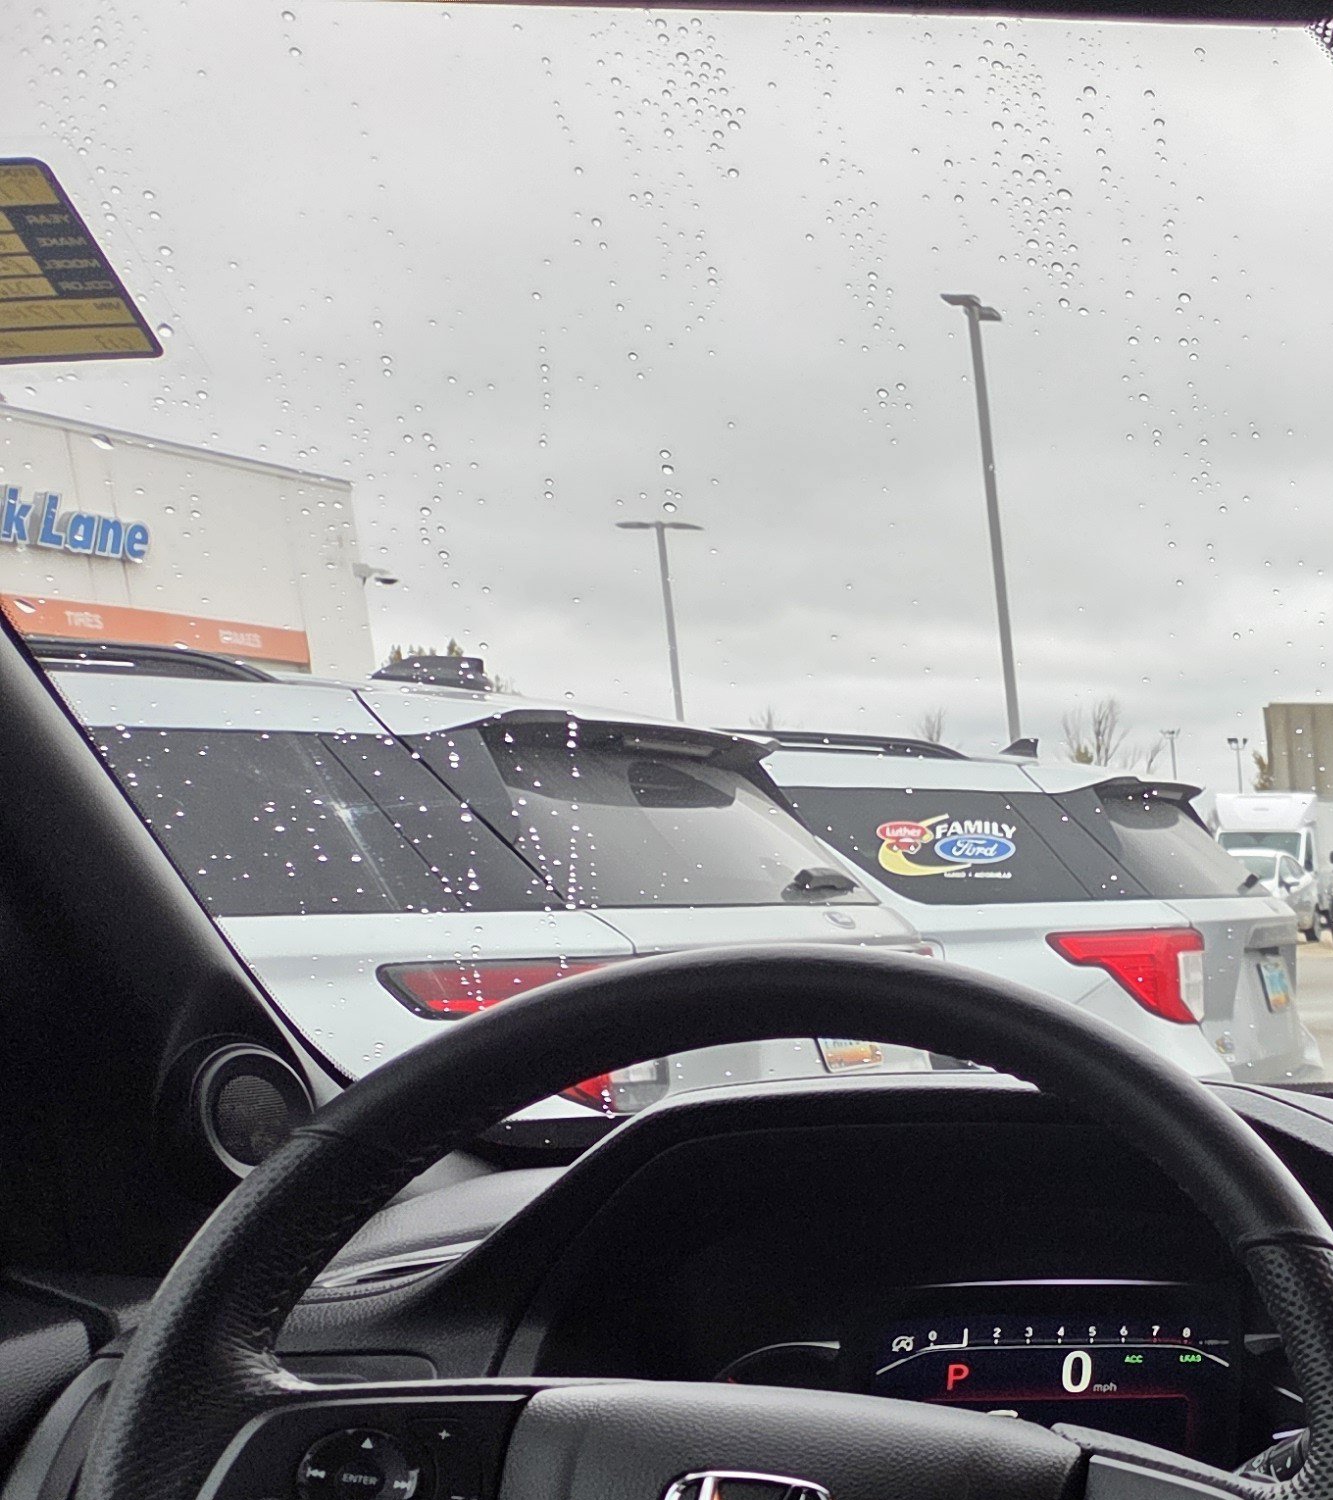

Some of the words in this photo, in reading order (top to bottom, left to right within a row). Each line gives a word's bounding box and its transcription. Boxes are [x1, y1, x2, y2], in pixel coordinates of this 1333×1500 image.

[38, 491, 149, 562] Lane
[64, 610, 104, 630] TIRES
[885, 826, 923, 837] Luther
[935, 819, 1017, 840] FAMILY
[951, 839, 1000, 857] Ford
[927, 1330, 938, 1342] 0
[992, 1326, 1002, 1339] 2
[1024, 1326, 1034, 1338] 3
[1056, 1325, 1066, 1337] 4
[1088, 1325, 1097, 1337] 5
[1119, 1325, 1129, 1337] 6
[1151, 1325, 1161, 1336] 7
[1182, 1326, 1192, 1338] 8
[946, 1363, 970, 1391] P
[1061, 1350, 1093, 1393] 0
[1093, 1382, 1118, 1393] mph
[342, 1473, 378, 1486] ENTER
